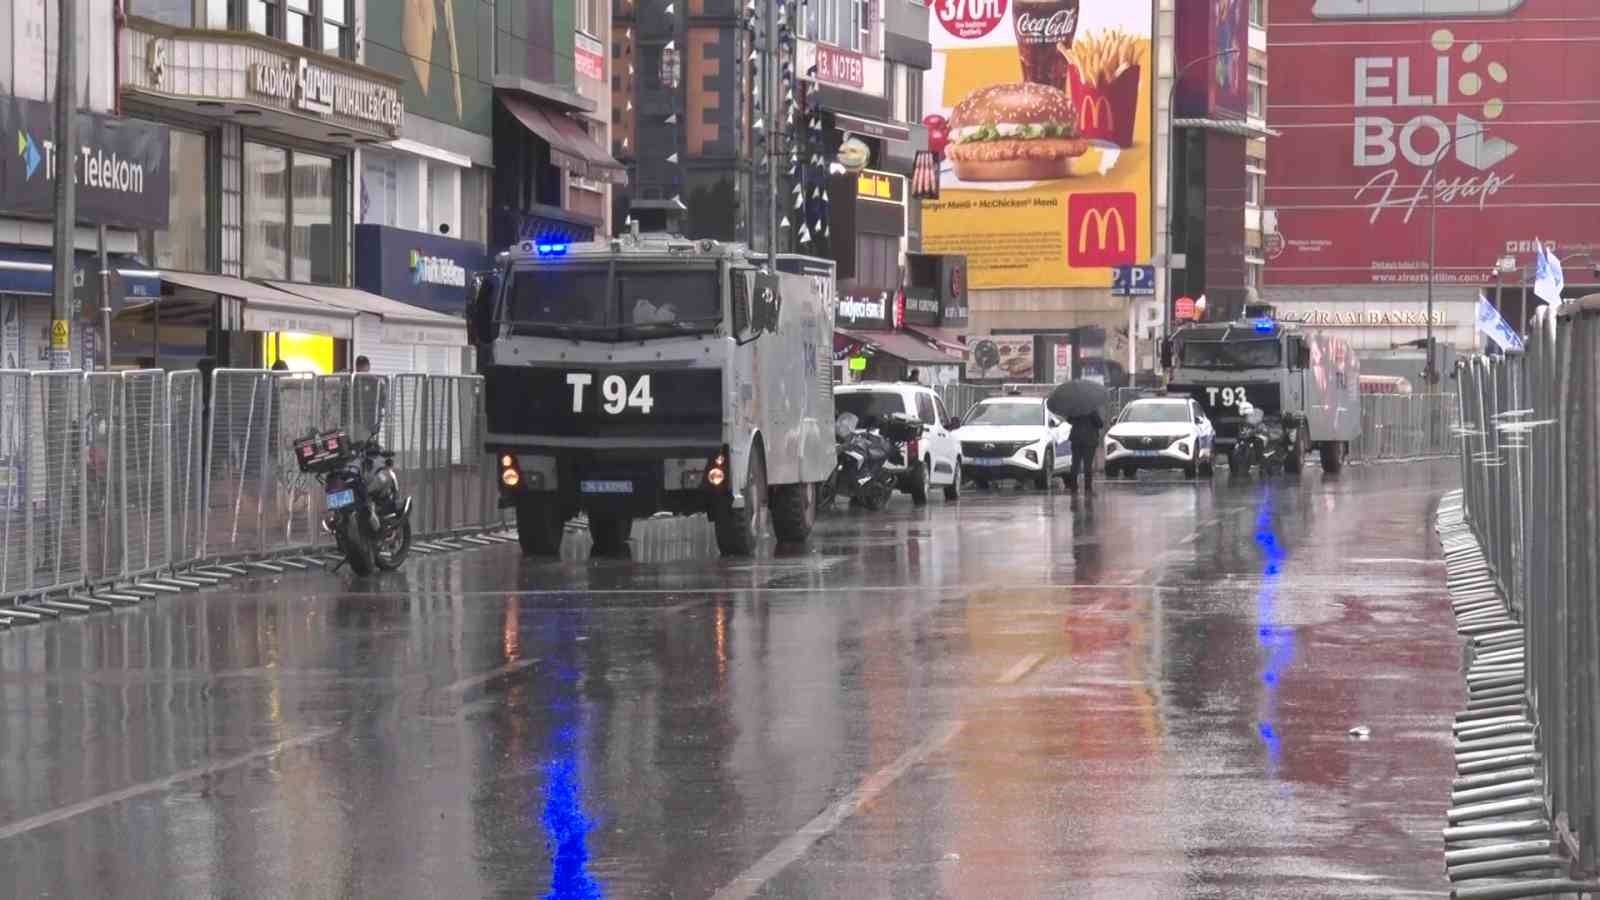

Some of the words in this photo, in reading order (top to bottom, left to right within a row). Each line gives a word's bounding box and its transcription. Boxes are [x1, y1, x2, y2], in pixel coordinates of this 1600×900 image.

[256, 64, 297, 98] KADIKÖY
[818, 49, 829, 75] 13.
[832, 53, 862, 82] NOTER
[81, 146, 143, 193] Telekom
[1353, 168, 1515, 224] Hesap
[1131, 267, 1145, 286] P
[1368, 310, 1447, 325] BANKASI
[566, 373, 592, 412] T
[602, 374, 654, 414] 94
[1206, 387, 1219, 407] T
